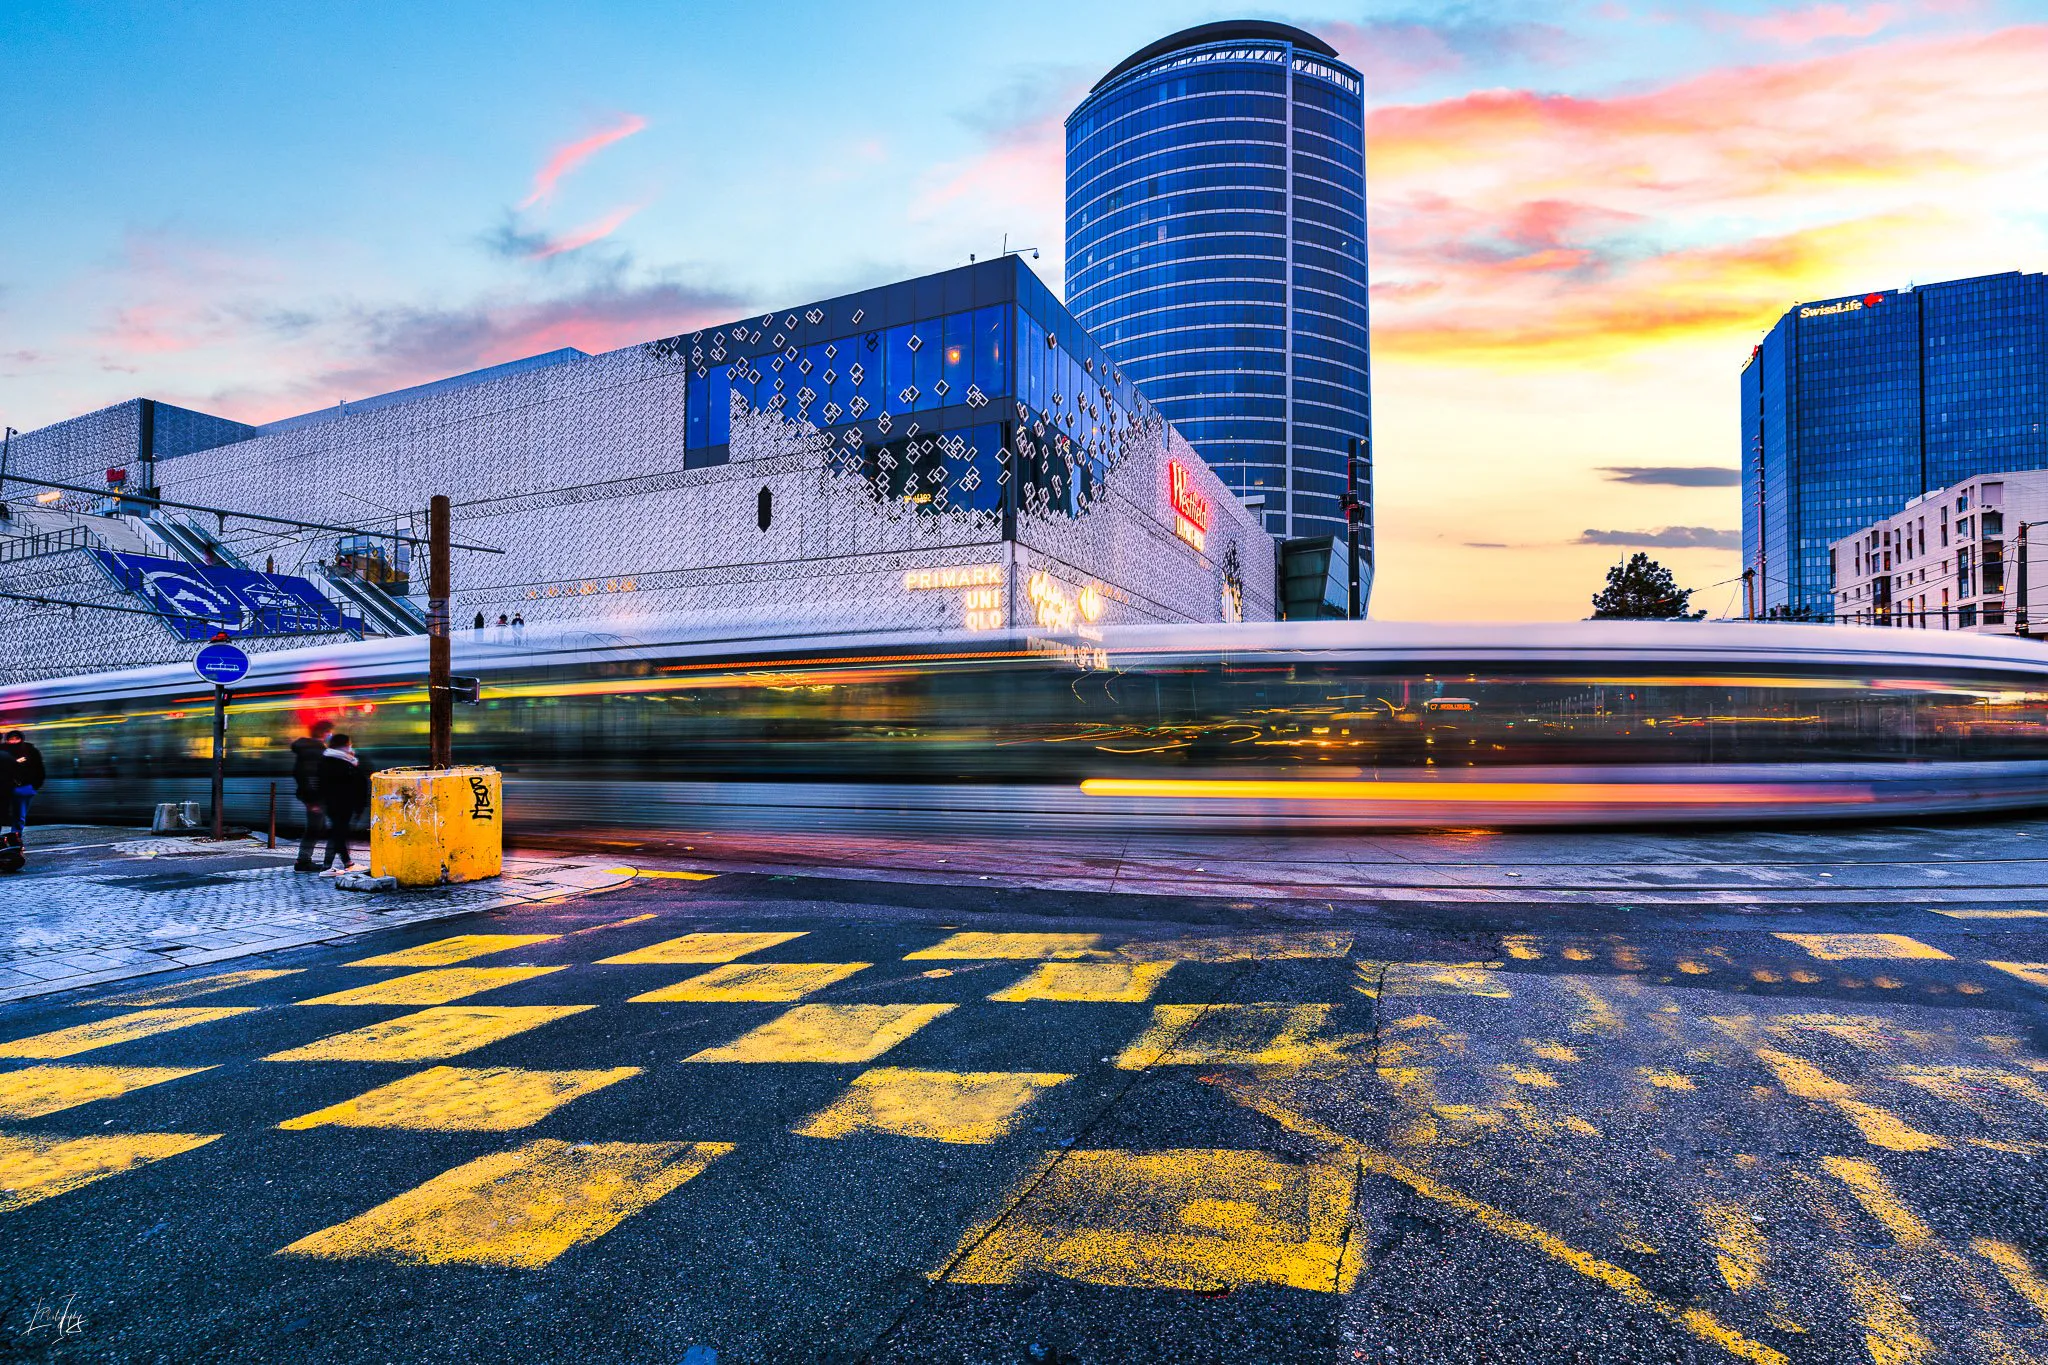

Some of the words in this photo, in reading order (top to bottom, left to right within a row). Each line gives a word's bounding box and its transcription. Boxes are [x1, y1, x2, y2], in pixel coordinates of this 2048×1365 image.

[1800, 300, 1863, 319] SwissLife
[1169, 461, 1208, 530] Westfield
[907, 564, 1001, 590] PRIMARK
[967, 590, 1000, 609] UNI
[967, 610, 1001, 632] QLO
